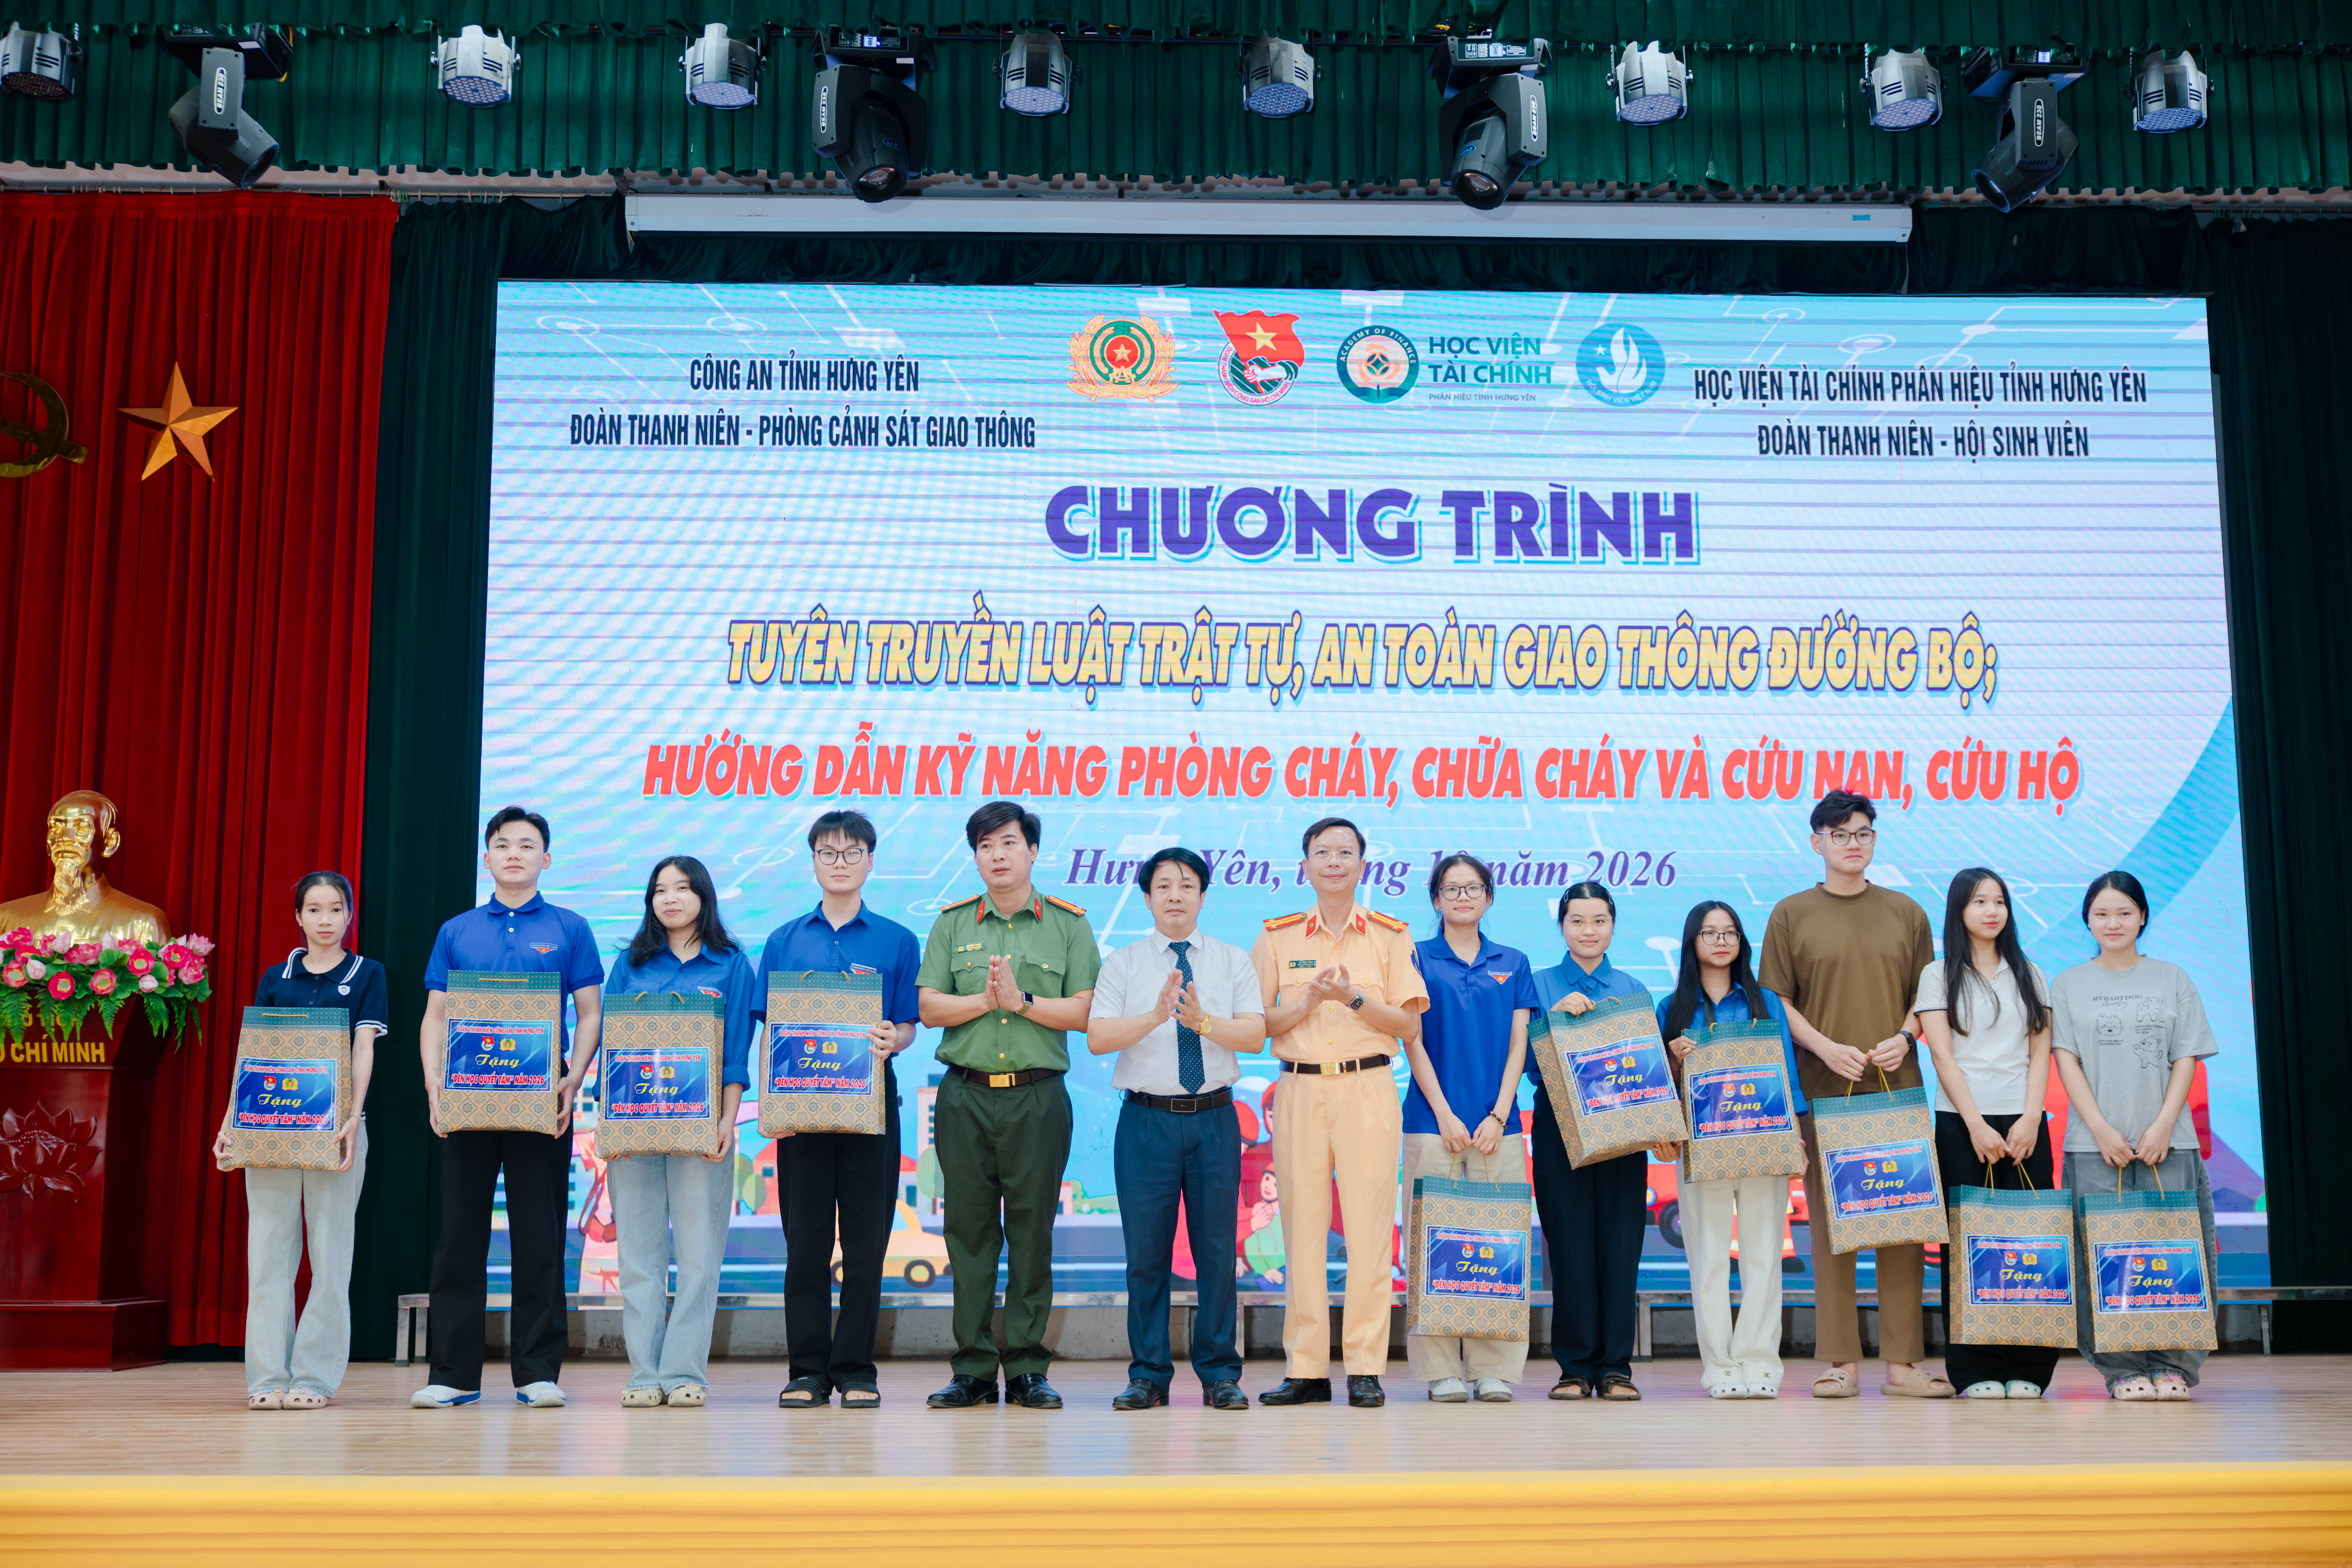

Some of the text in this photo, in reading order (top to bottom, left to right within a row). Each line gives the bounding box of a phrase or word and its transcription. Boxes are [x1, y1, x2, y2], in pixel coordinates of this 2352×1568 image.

[216, 87, 225, 109] BEAM
[1339, 329, 1369, 362] ACADEMY
[1390, 331, 1416, 364] FINANCE
[1429, 332, 1541, 359] HỌC VIỆN
[690, 349, 919, 392] CÔNG AN TỈNH HƯNG YÊN
[1428, 360, 1552, 384] TÀI CHÍNH
[1694, 361, 2147, 408] HỌC VIỆN TÀI CHÍNH PHÂN HIỆU TỈNH HƯNG YÊN
[570, 407, 621, 445] ĐOÀN
[628, 414, 689, 445] THANH
[695, 408, 740, 446] NIÊN
[759, 407, 822, 446] PHÒNG
[828, 404, 879, 446] CẢNH
[885, 409, 920, 447] SÁT
[926, 416, 969, 447] GIAO
[975, 410, 1035, 448] THÔNG
[1758, 418, 1811, 456] ĐOÀN
[1817, 426, 1880, 456] THANH
[1887, 419, 1933, 456] NIÊN
[1953, 419, 1985, 463] HỘI
[1993, 426, 2039, 457] SINH
[2044, 420, 2089, 457] VIÊN
[1046, 483, 1693, 557] CHƯƠNG TRÌNH
[728, 590, 1997, 710] TUYÊN TRUYỀN LUẬT TRẬT TỰ, AN TOÀN GIAO THÔNG ĐƯỜNG BỘ;
[643, 728, 802, 795] HƯỚNG
[813, 722, 906, 795] DẪN
[915, 733, 976, 795] KỸ
[982, 729, 1107, 797] NĂNG
[1118, 731, 1272, 797] PHÒNG
[1285, 732, 1397, 808] CHÁY,
[1413, 736, 1522, 798] CHỮA
[1536, 734, 1646, 799] CHÁY
[1657, 735, 1709, 798] VÀ
[1722, 735, 1803, 800] CỨU
[1927, 736, 2007, 800] CỨU
[2018, 737, 2078, 815] HỘ
[1063, 848, 1140, 885] Hư
[1200, 848, 1279, 893] Yên,
[1489, 850, 1569, 886] năm
[1584, 850, 1677, 887] 2026
[10, 1034, 48, 1063] CHÍ
[51, 1042, 105, 1063] MINH
[475, 1054, 521, 1068] Tặng
[798, 1057, 842, 1071] Tặng
[466, 1074, 478, 1086] HỌC
[479, 1071, 497, 1085] QUYẾT
[514, 1073, 528, 1084] NĂM
[528, 1076, 544, 1084] 2026
[789, 1078, 801, 1089] HỌC
[802, 1074, 820, 1089] QUYẾT
[835, 1076, 849, 1088] NĂM
[850, 1079, 866, 1088] 2026
[1604, 1074, 1644, 1085] Tặng
[634, 1083, 680, 1096] Tặng
[258, 1094, 302, 1108] Tặng
[1719, 1101, 1762, 1112] Tặng
[1861, 1179, 1905, 1191] Tặng
[1856, 1200, 1868, 1212] HỌC
[1869, 1194, 1887, 1208] QUYẾT
[1903, 1191, 1916, 1203] NĂM
[1917, 1192, 1933, 1201] 2026
[1456, 1261, 1499, 1276] Tặng
[1999, 1269, 2043, 1282] Tặng
[1447, 1280, 1459, 1292] HỌC
[1460, 1278, 1478, 1292] QUYẾT
[1493, 1280, 1506, 1292] NĂM
[1506, 1284, 1520, 1293] 2026
[2128, 1275, 2174, 1288] Tặng
